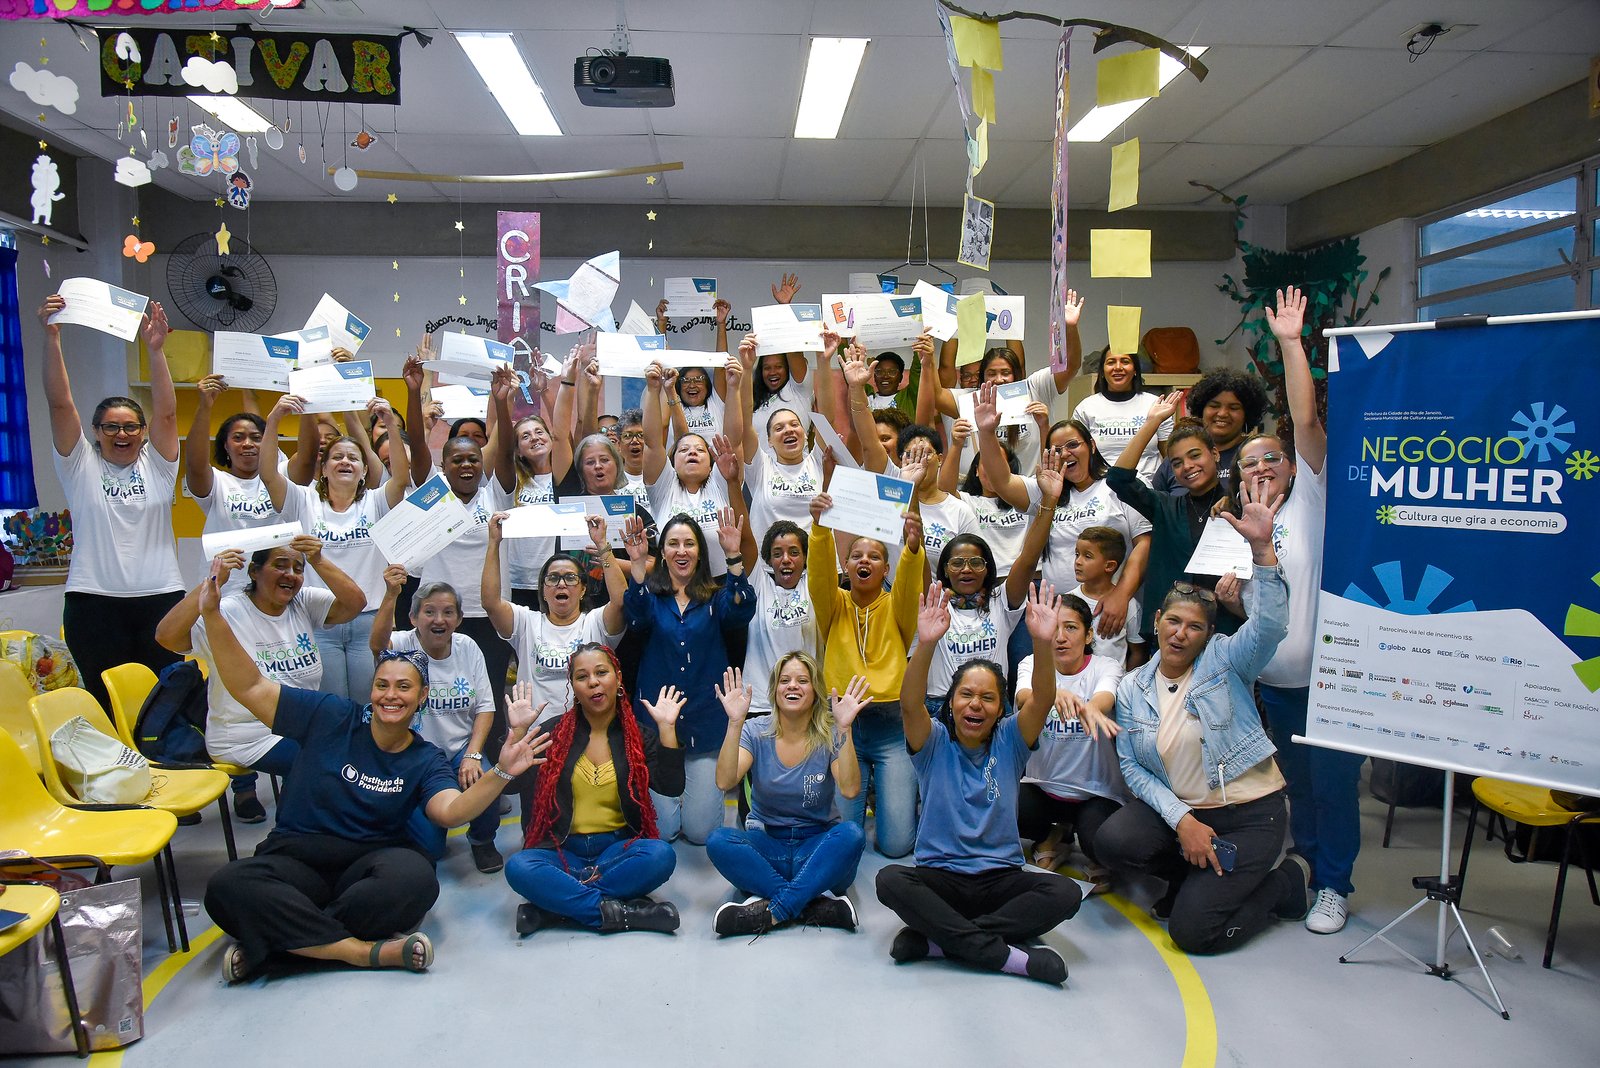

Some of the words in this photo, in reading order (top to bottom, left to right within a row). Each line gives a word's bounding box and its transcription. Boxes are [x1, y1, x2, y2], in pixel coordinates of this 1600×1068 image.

[425, 316, 455, 334] Educar
[1361, 430, 1525, 464] NEGÓCIO
[1348, 465, 1369, 482] DE
[1369, 465, 1563, 505] MULHER
[1398, 510, 1438, 522] Cultura
[1441, 515, 1463, 525] que
[1465, 514, 1487, 526] gira
[1500, 517, 1558, 528] economia
[1379, 625, 1408, 634] Patrocínio
[1435, 632, 1462, 640] incentivo
[947, 637, 996, 655] MULHER
[1387, 643, 1406, 652] globo
[264, 652, 318, 672] MULHER
[1510, 657, 1523, 665] Rio
[1324, 682, 1336, 691] phi
[1524, 696, 1550, 705] CASACOR
[1554, 700, 1571, 709] DOAR
[1572, 703, 1599, 714] FASHION
[360, 772, 392, 786] Instituto
[393, 777, 404, 785] da
